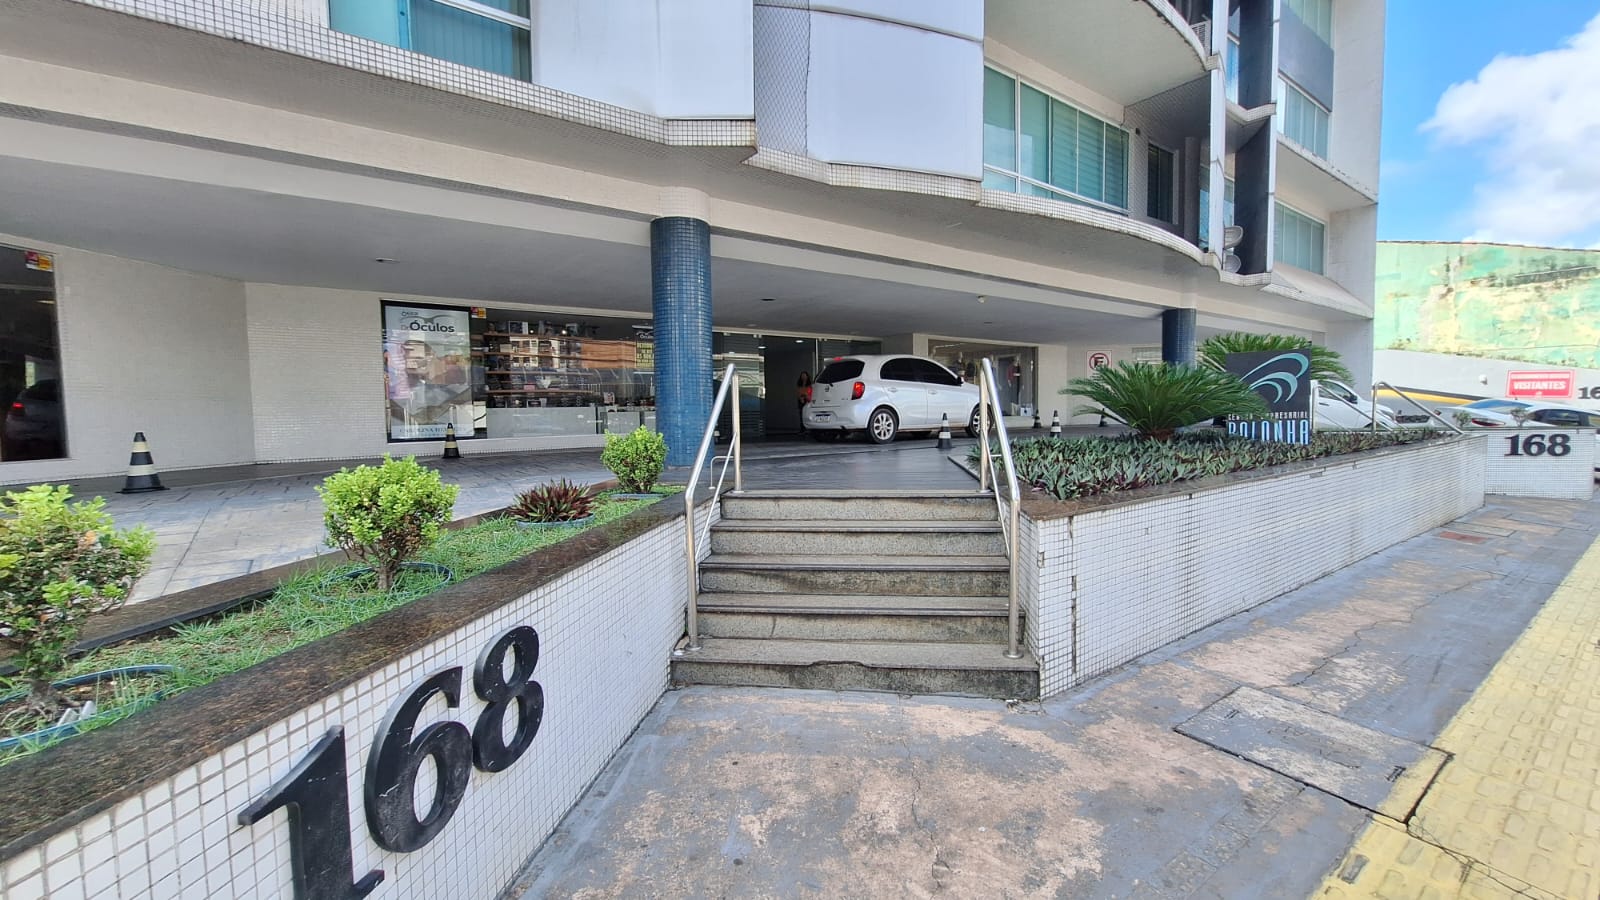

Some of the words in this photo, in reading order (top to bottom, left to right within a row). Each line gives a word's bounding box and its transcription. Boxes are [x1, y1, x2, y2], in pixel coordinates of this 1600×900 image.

[409, 319, 455, 333] Óculos
[1513, 380, 1566, 390] VISITANTES
[1504, 433, 1571, 457] 168
[237, 626, 544, 900] 168
